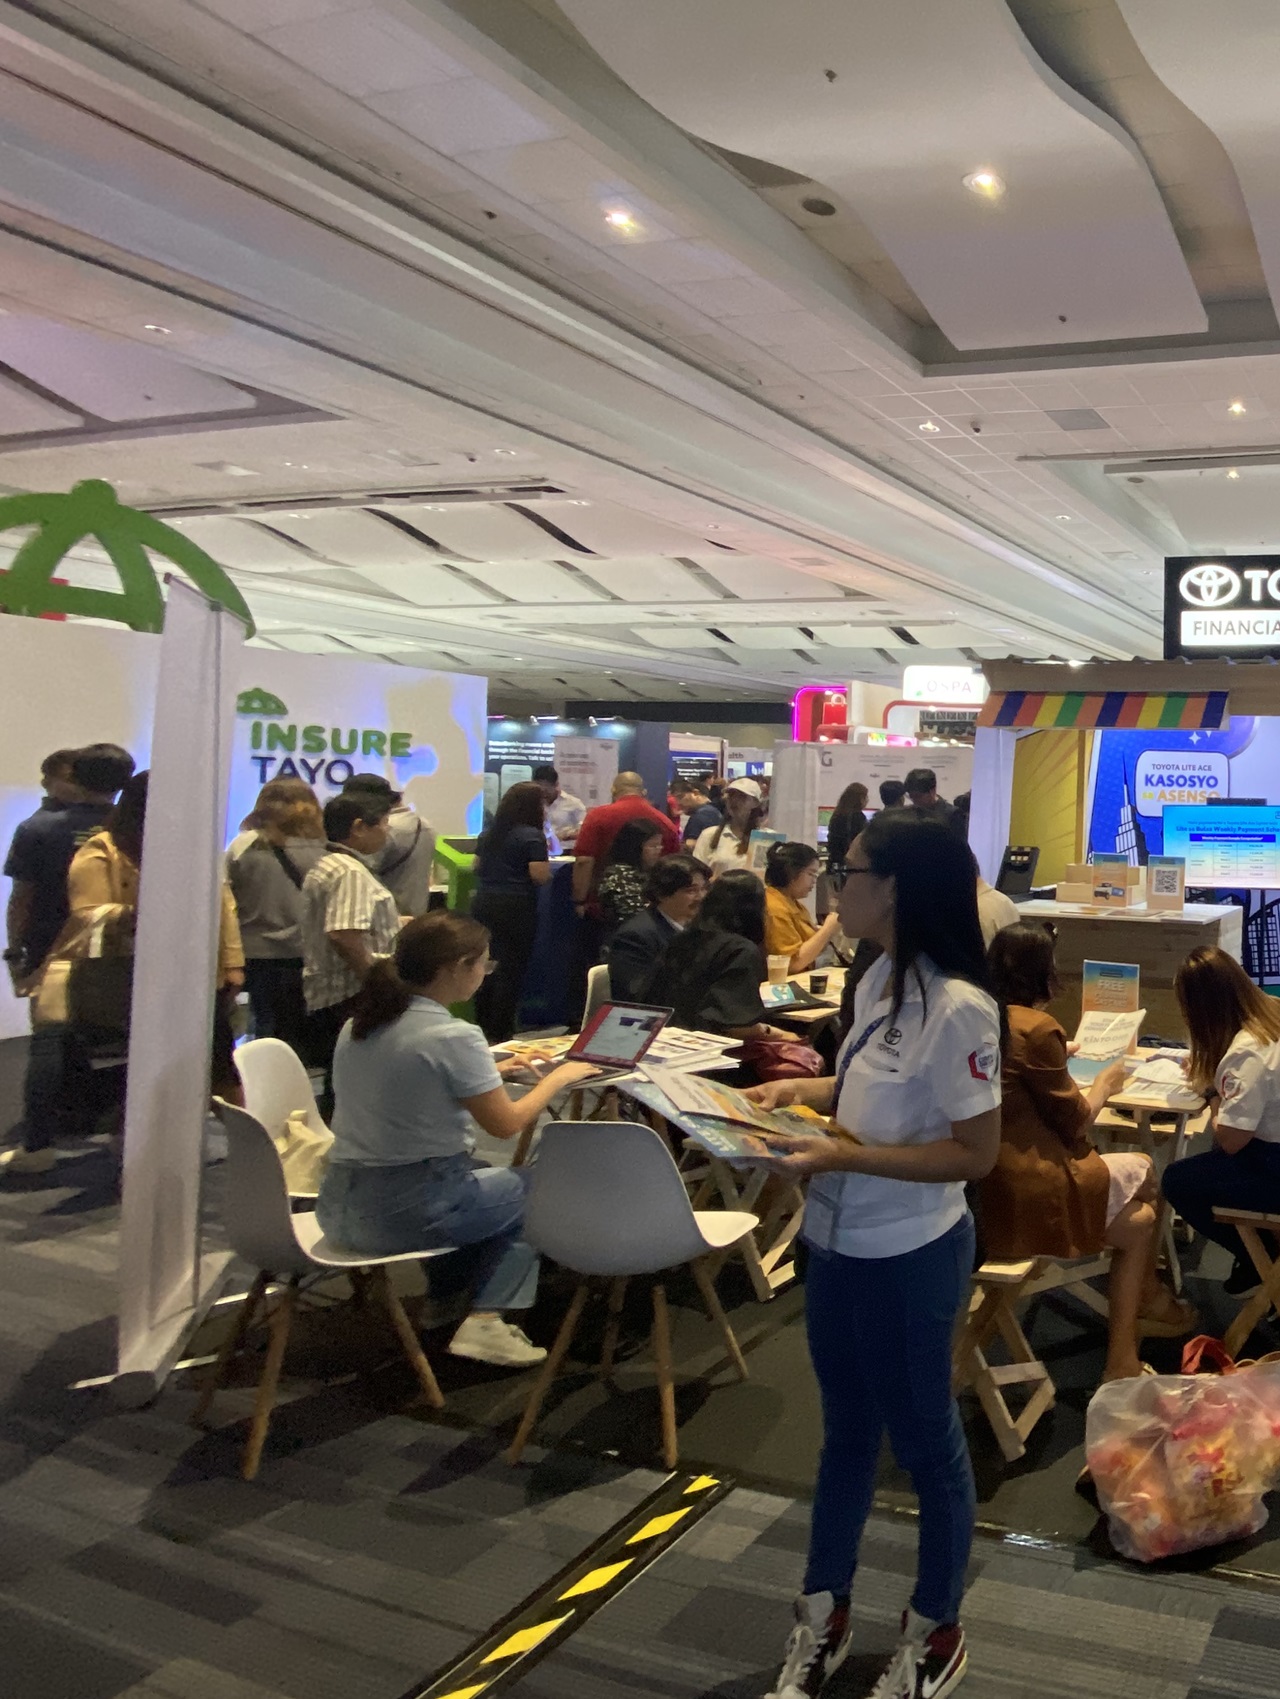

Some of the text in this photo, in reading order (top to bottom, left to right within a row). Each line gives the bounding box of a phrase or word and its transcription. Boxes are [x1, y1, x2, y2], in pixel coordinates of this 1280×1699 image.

[251, 721, 412, 757] INSURE
[251, 756, 354, 785] TAYO
[1152, 763, 1180, 771] TOYOTA
[1144, 774, 1219, 788] KASOSYO
